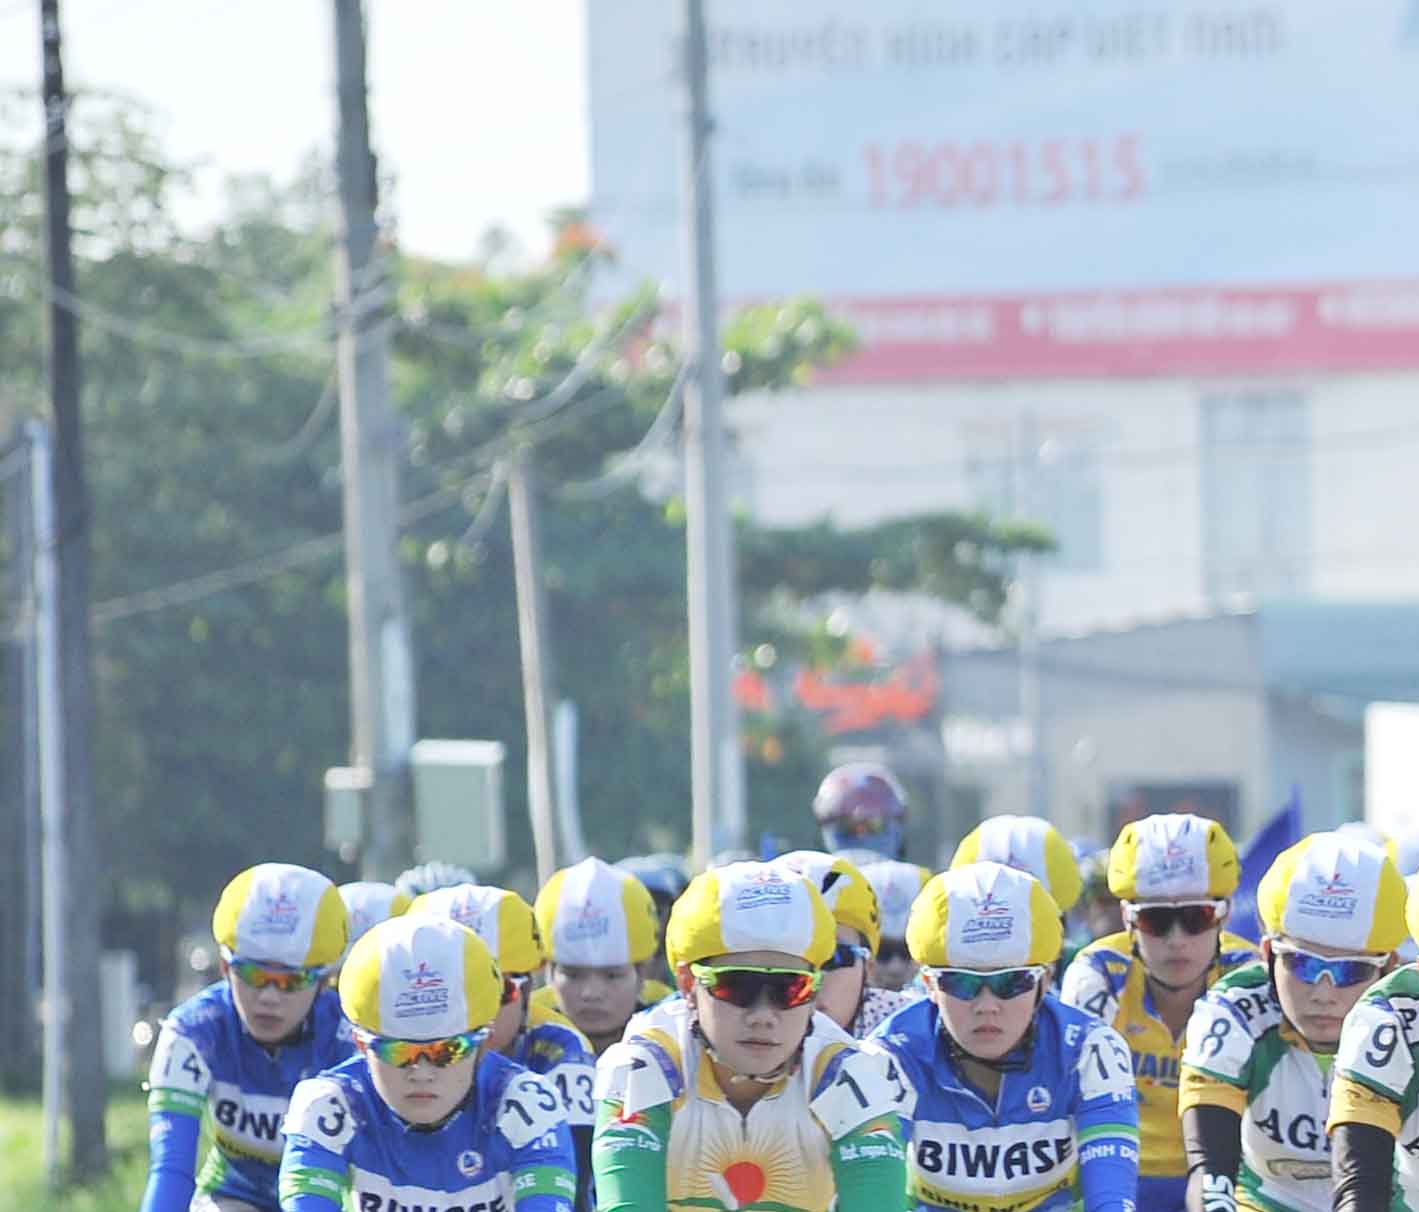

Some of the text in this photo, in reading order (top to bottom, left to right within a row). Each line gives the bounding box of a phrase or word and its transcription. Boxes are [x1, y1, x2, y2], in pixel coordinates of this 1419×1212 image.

[862, 134, 1148, 209] 19001515
[1200, 1016, 1231, 1057] 8
[1366, 1023, 1397, 1067] 9
[164, 1053, 202, 1083] 14
[504, 1080, 558, 1126] 13
[918, 1136, 1072, 1181] BIWASE
